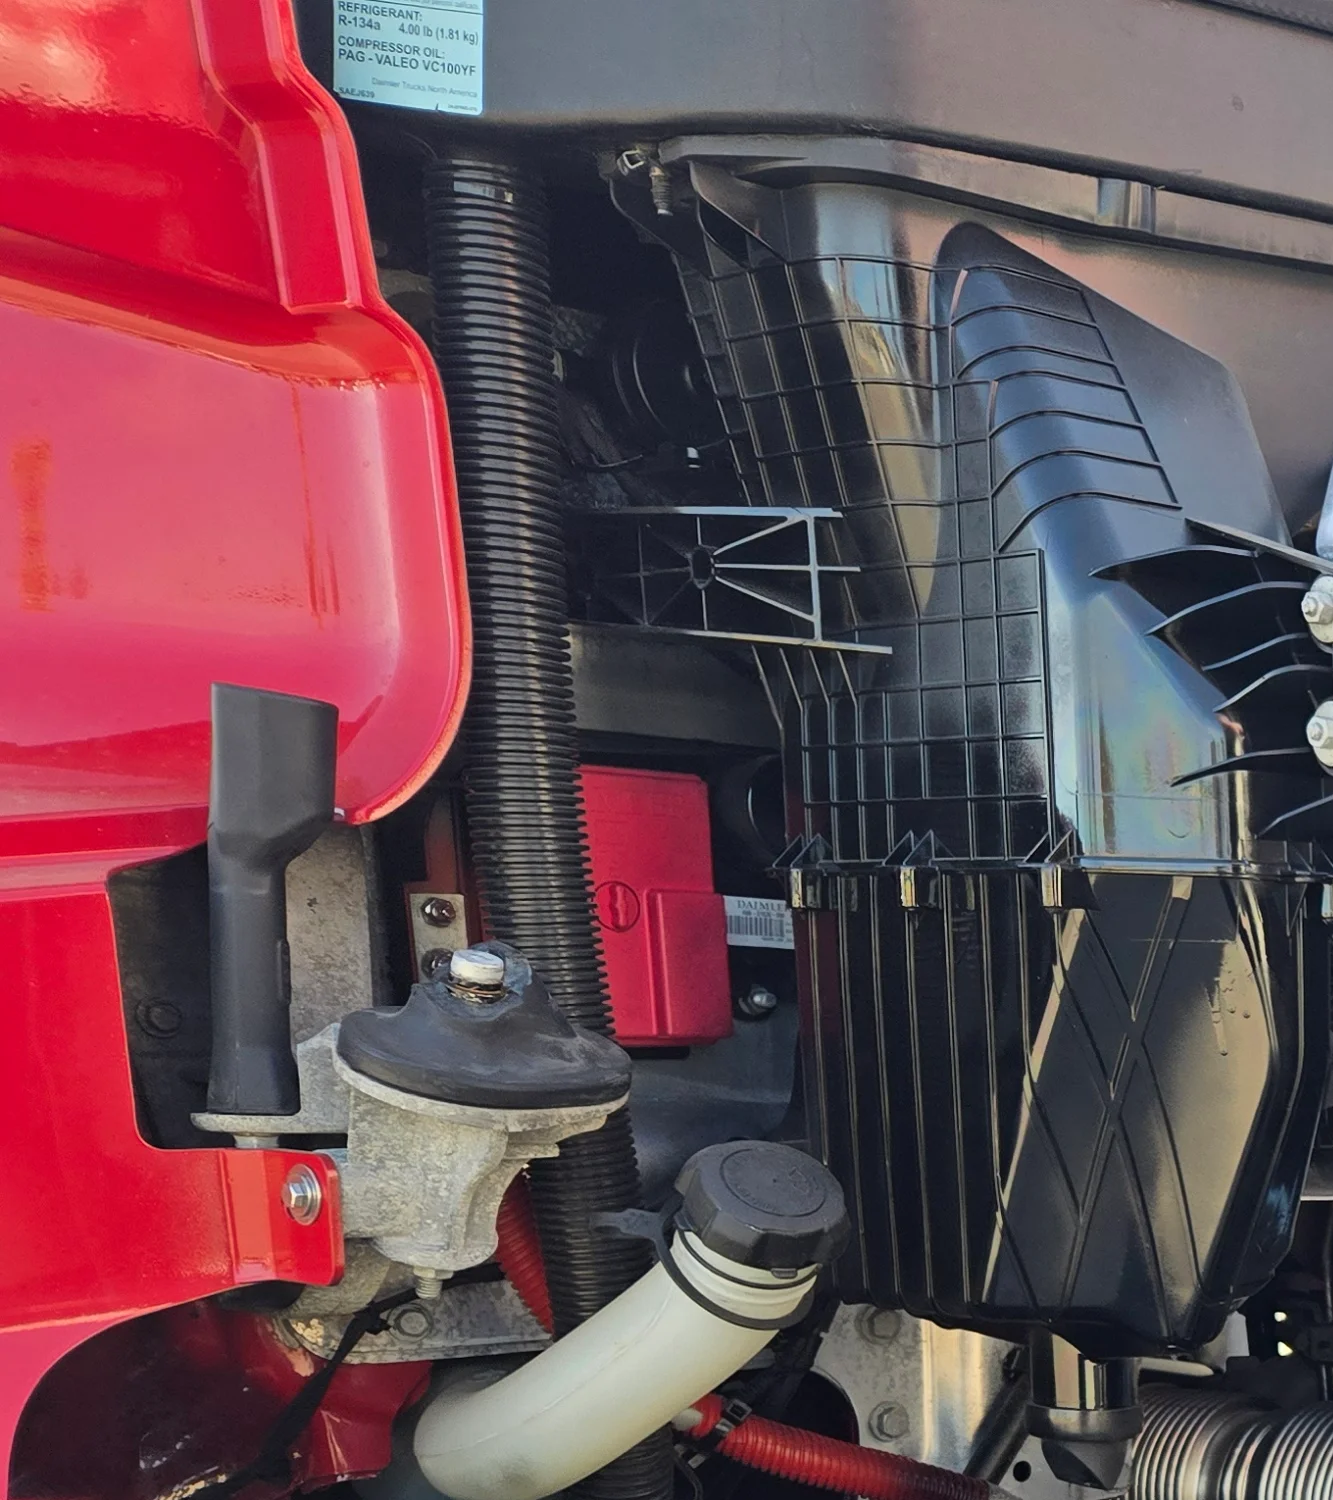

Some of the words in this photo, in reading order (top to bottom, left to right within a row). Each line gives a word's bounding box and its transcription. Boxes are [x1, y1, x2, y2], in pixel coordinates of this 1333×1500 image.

[338, 2, 423, 22] REFRIGERANT:
[338, 14, 381, 31] R-134a
[399, 23, 421, 36] 4.00
[423, 26, 433, 38] lb
[435, 27, 460, 41] (1.81
[463, 30, 479, 46] kg)
[338, 35, 421, 56] COMPRESSOR
[424, 47, 446, 60] OIL:
[338, 48, 366, 63] PAG
[375, 53, 419, 70] VALEO
[422, 59, 477, 77] VC100YF
[737, 899, 788, 912] DAIMLE
